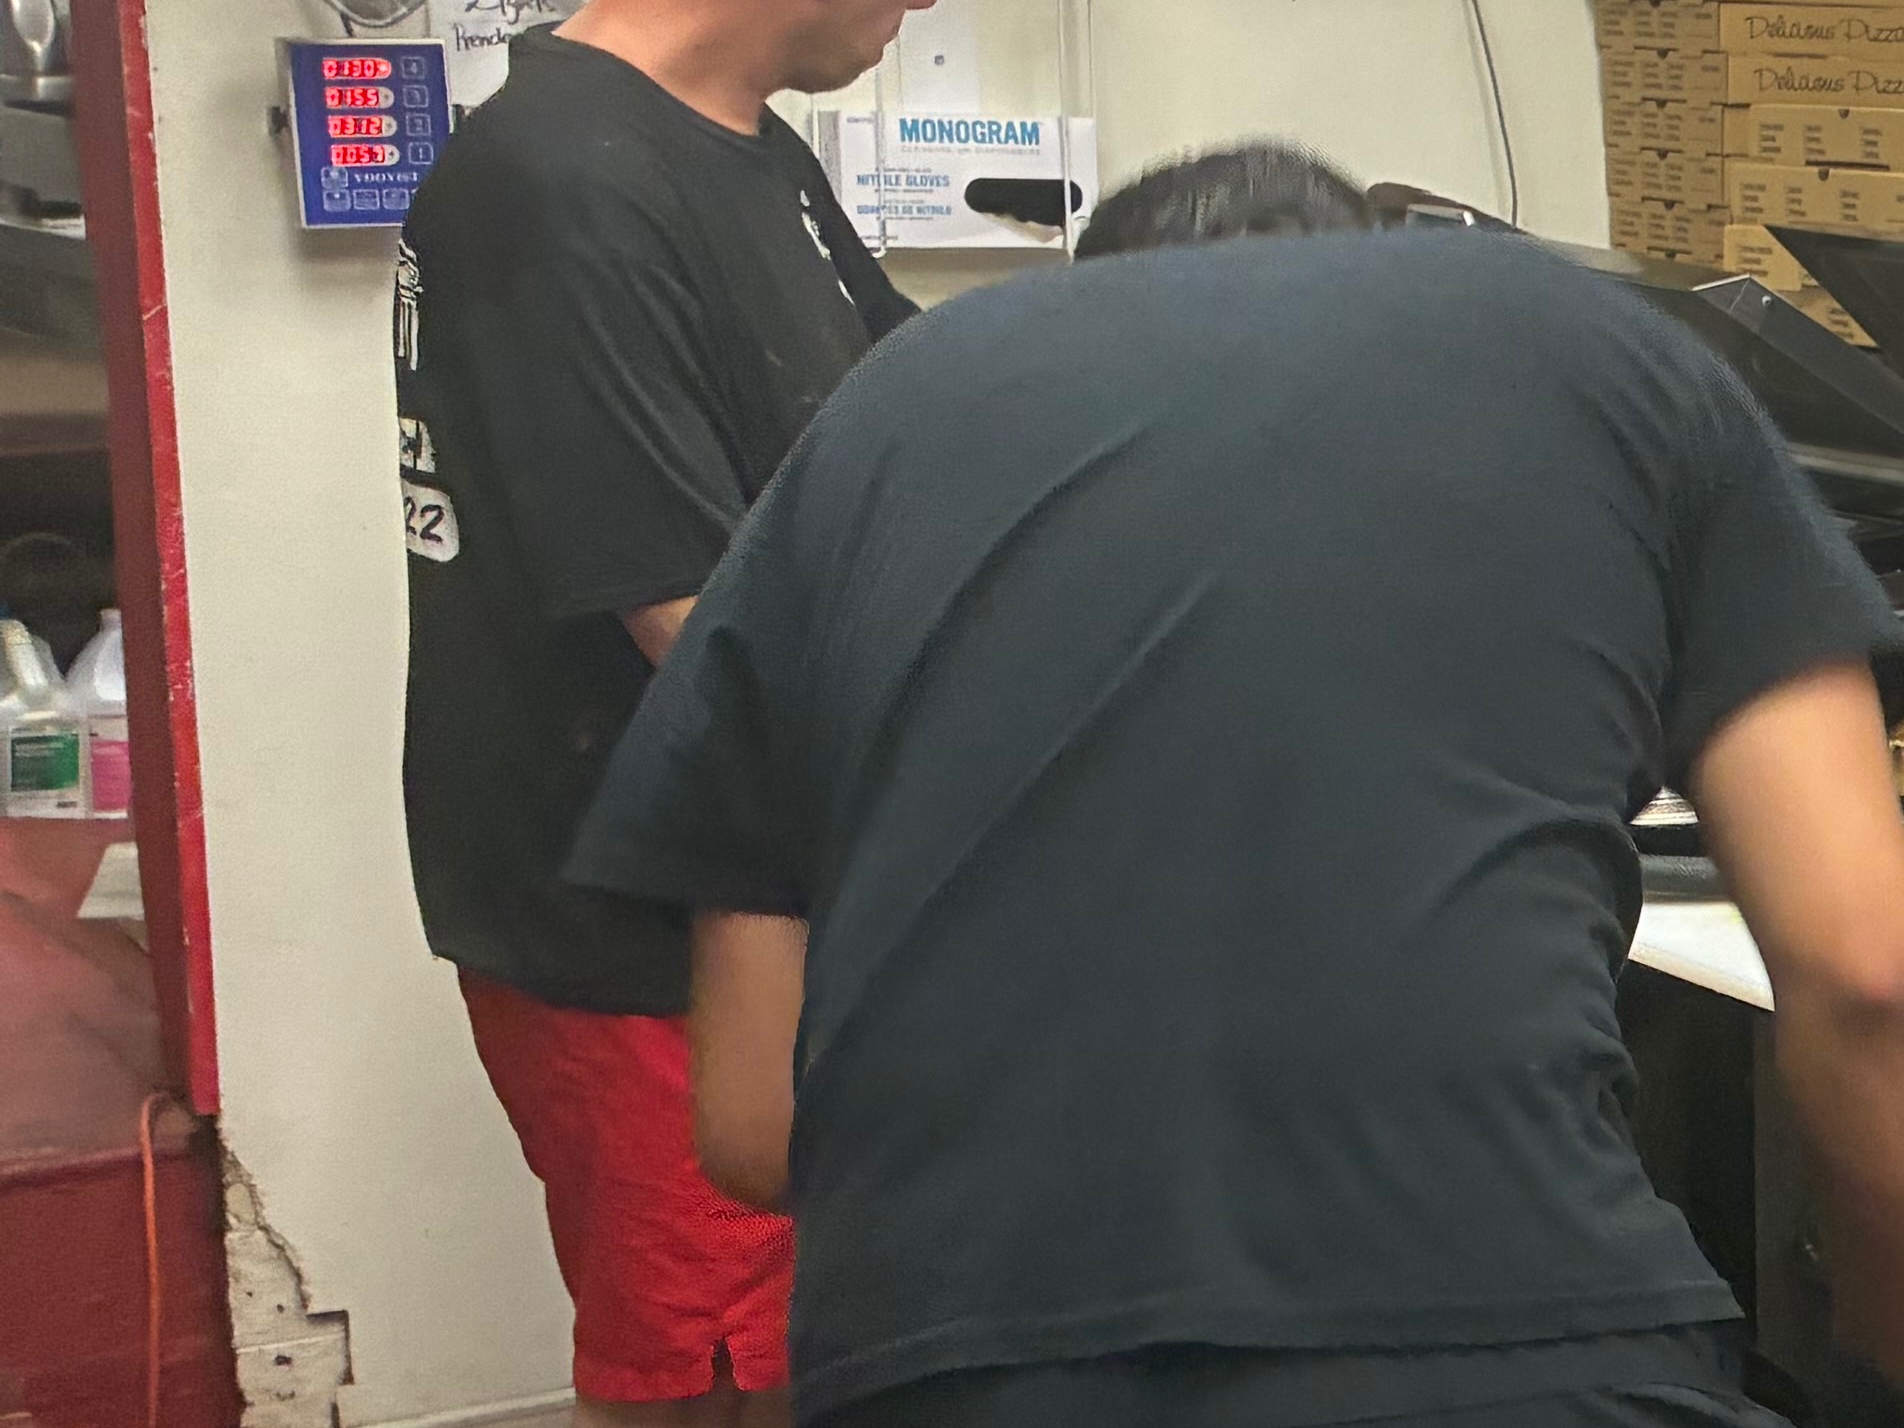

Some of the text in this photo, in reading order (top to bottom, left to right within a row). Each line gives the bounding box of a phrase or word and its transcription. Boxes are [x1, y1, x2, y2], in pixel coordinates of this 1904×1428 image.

[1746, 16, 1837, 43] Delicious
[1753, 68, 1845, 95] Delicious
[326, 88, 379, 108] 0155
[899, 118, 1041, 146] MONOGRAM
[905, 175, 950, 188] GLOVES
